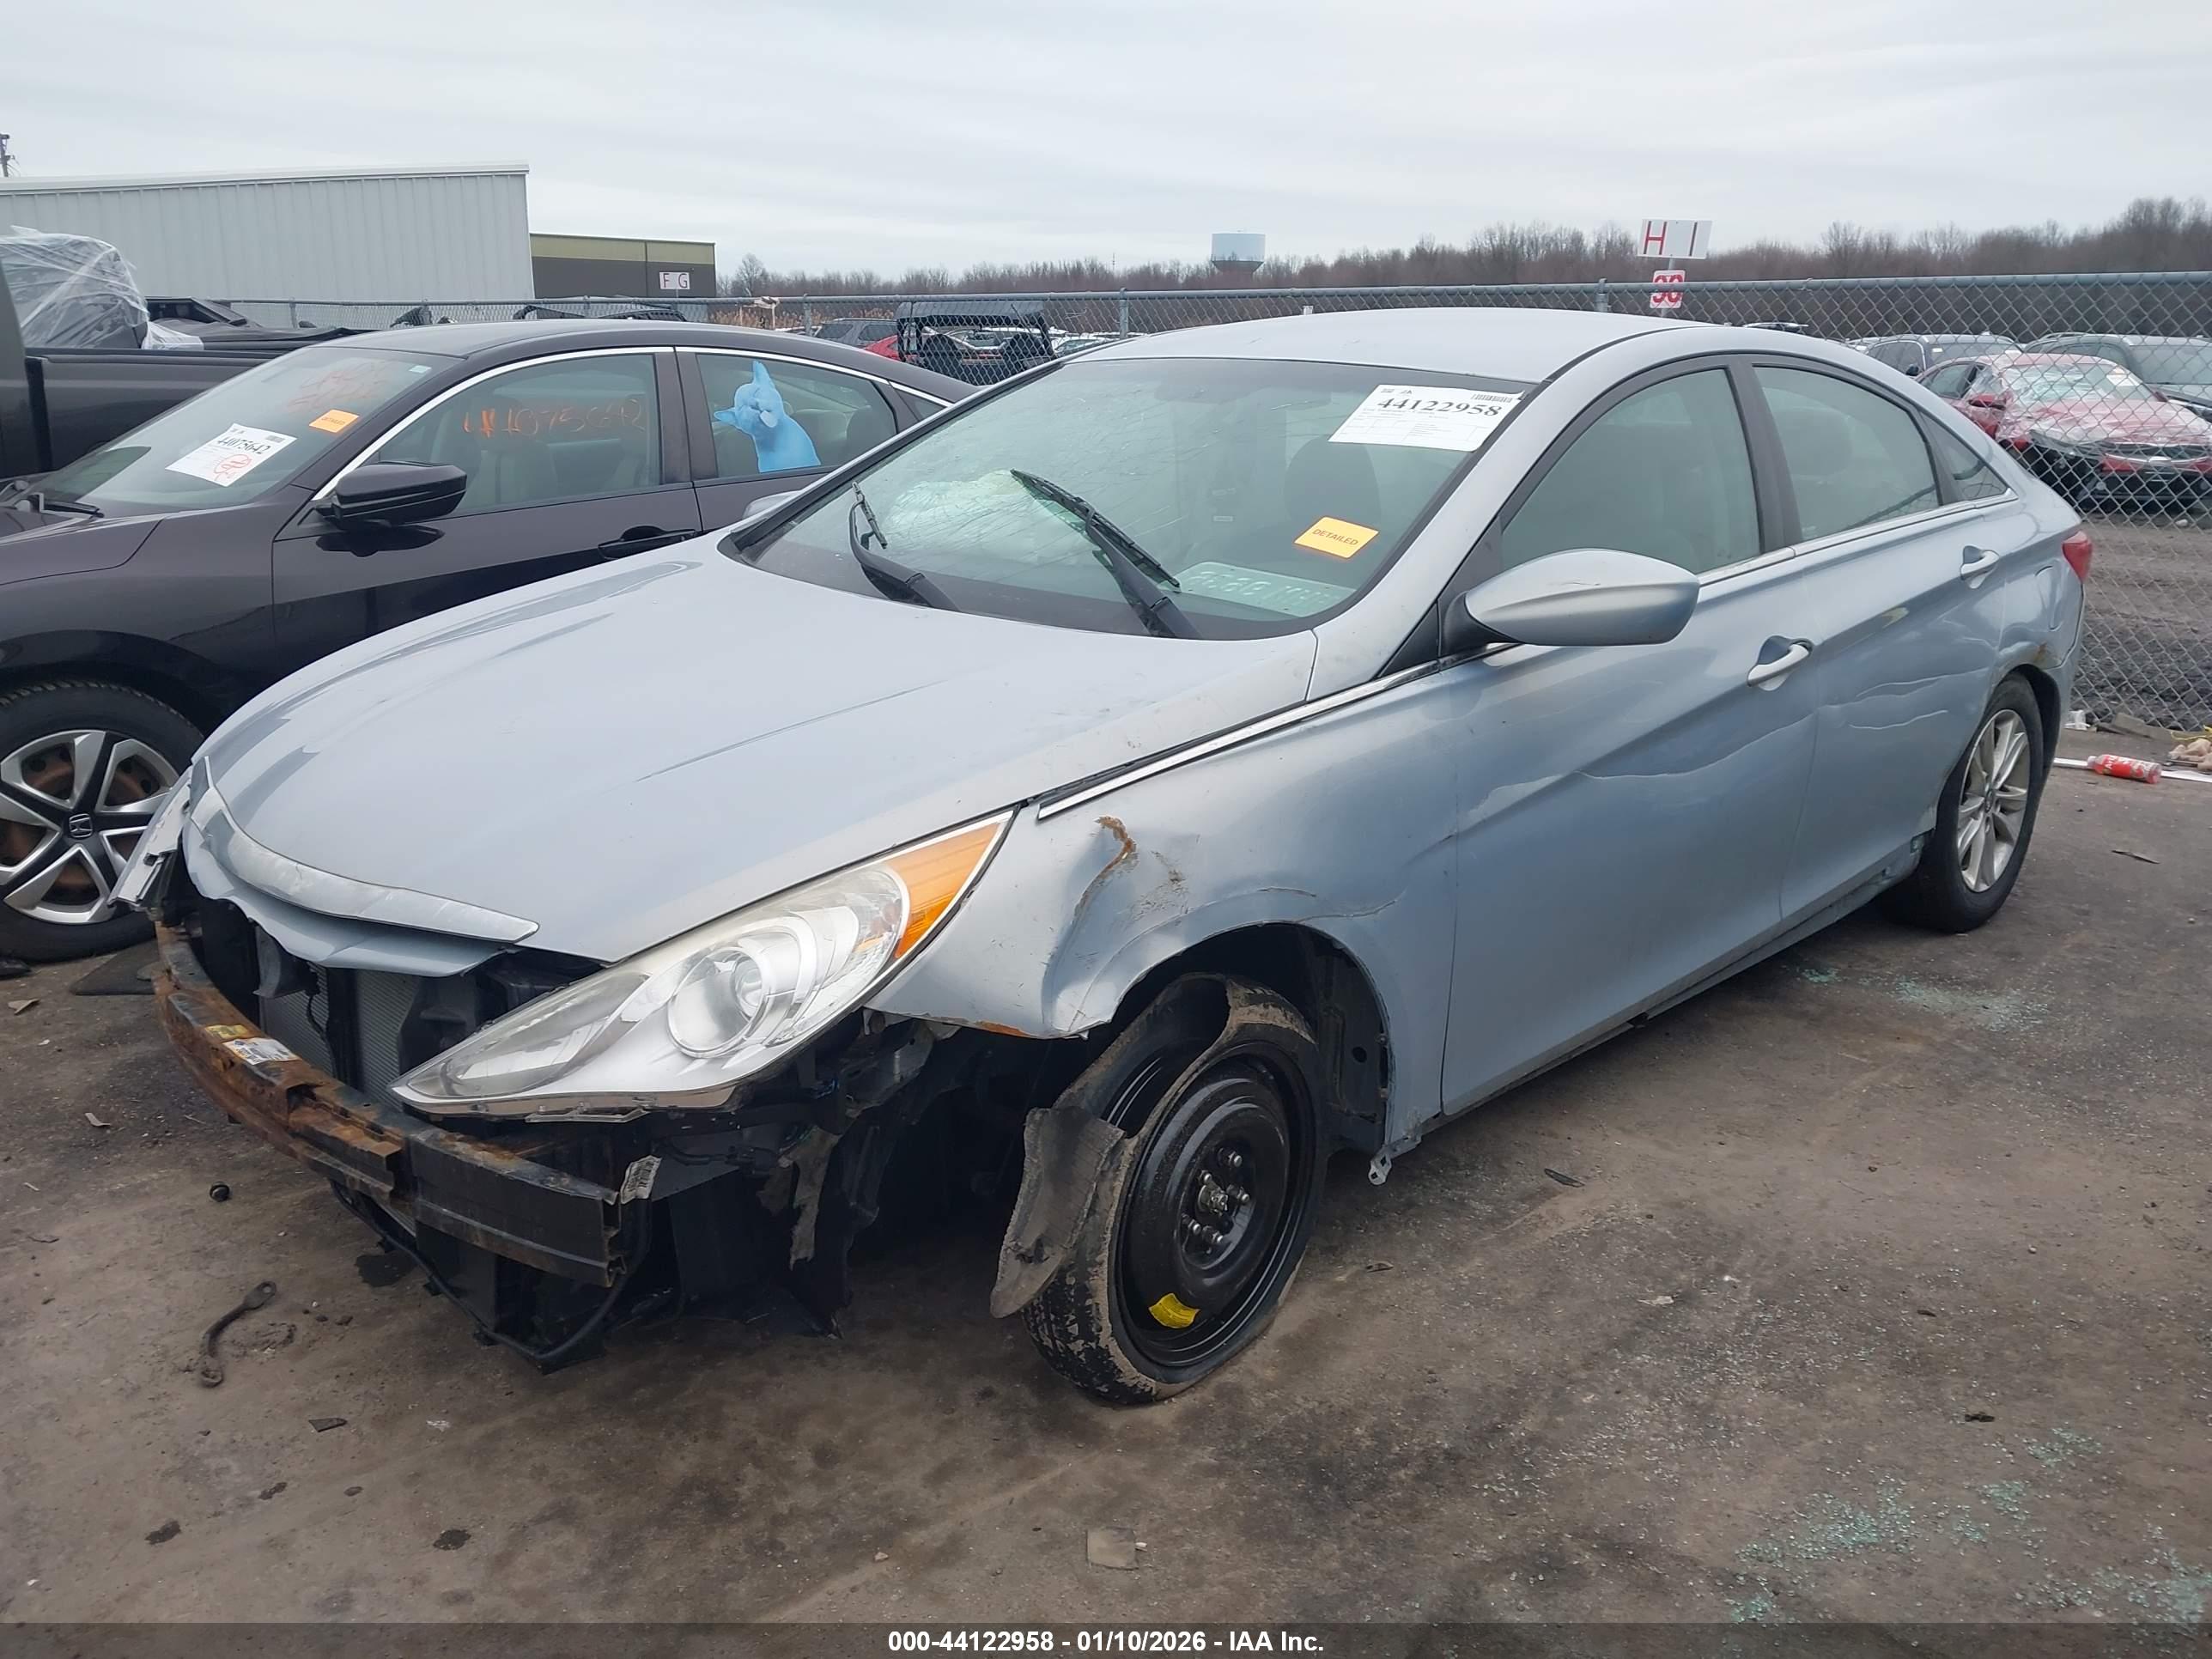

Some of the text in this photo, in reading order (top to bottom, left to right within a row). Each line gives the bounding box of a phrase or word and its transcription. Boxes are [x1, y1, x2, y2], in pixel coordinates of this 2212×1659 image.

[1644, 221, 1668, 255] H
[663, 273, 688, 289] F G
[1377, 398, 1503, 416] 44122958
[1312, 528, 1359, 546] DETAILED
